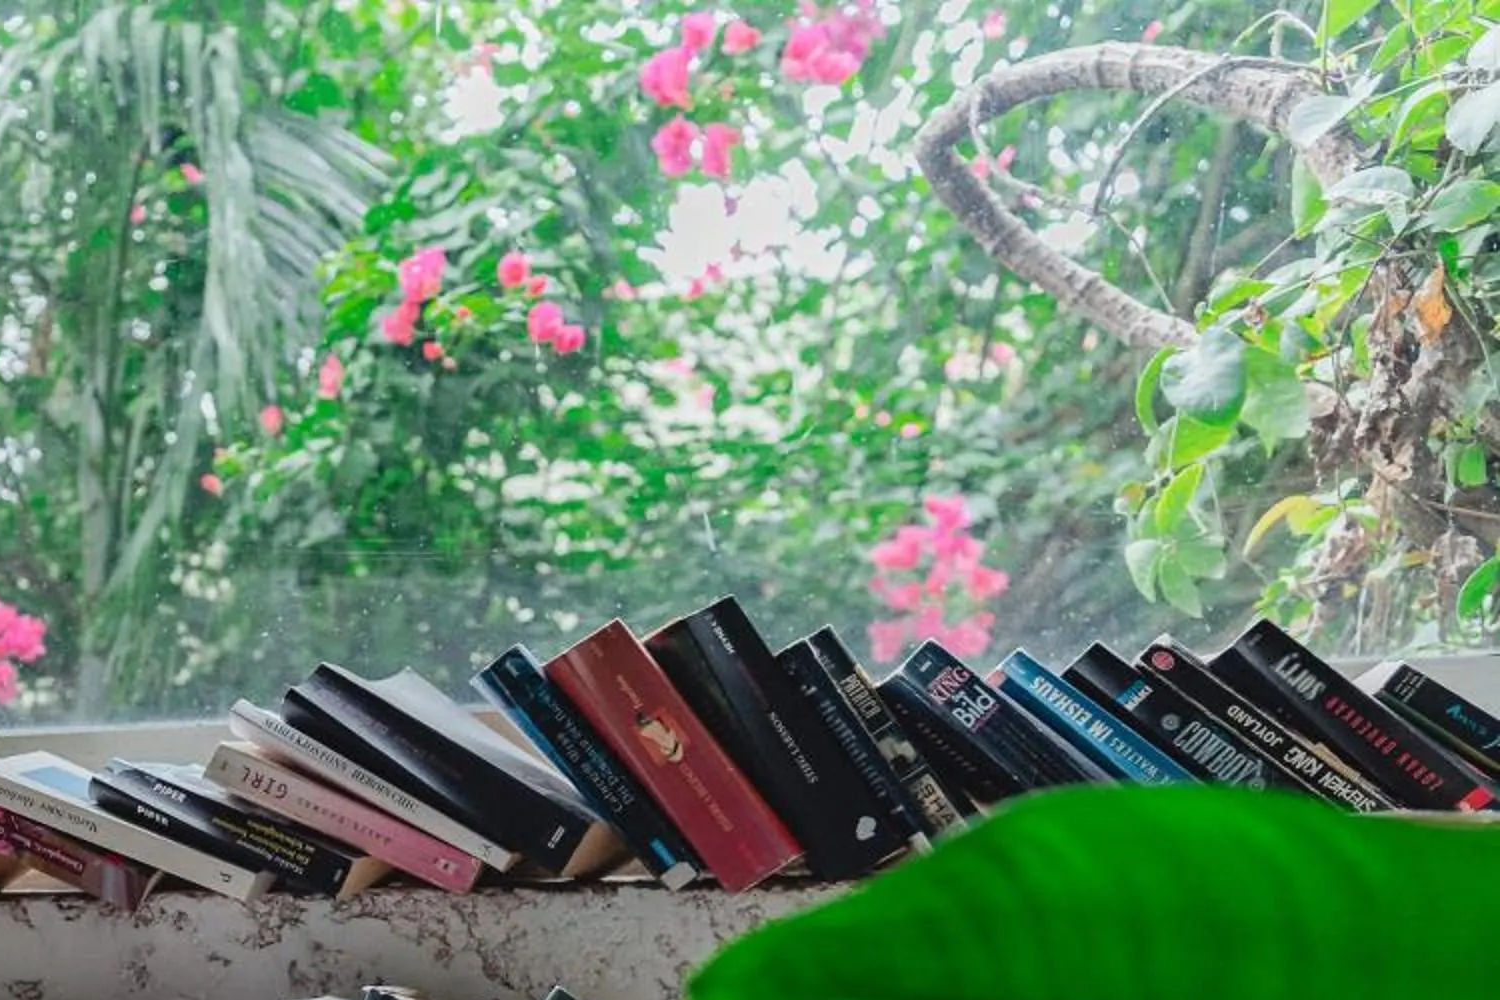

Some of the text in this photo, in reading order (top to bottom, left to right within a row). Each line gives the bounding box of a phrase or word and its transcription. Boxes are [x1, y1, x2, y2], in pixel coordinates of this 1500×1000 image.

[930, 667, 970, 706] KING
[952, 684, 997, 729] Bild
[1030, 675, 1113, 742] IM EISHAUS
[1324, 695, 1398, 754] DRVENKAR
[1109, 735, 1159, 778] WALTERS
[1226, 703, 1377, 815] STEPHEN KING JOYLAND
[1394, 752, 1445, 793] ZORAN
[152, 779, 187, 805] PIPER
[241, 764, 290, 800] GIRL
[134, 803, 170, 829] PIPER
